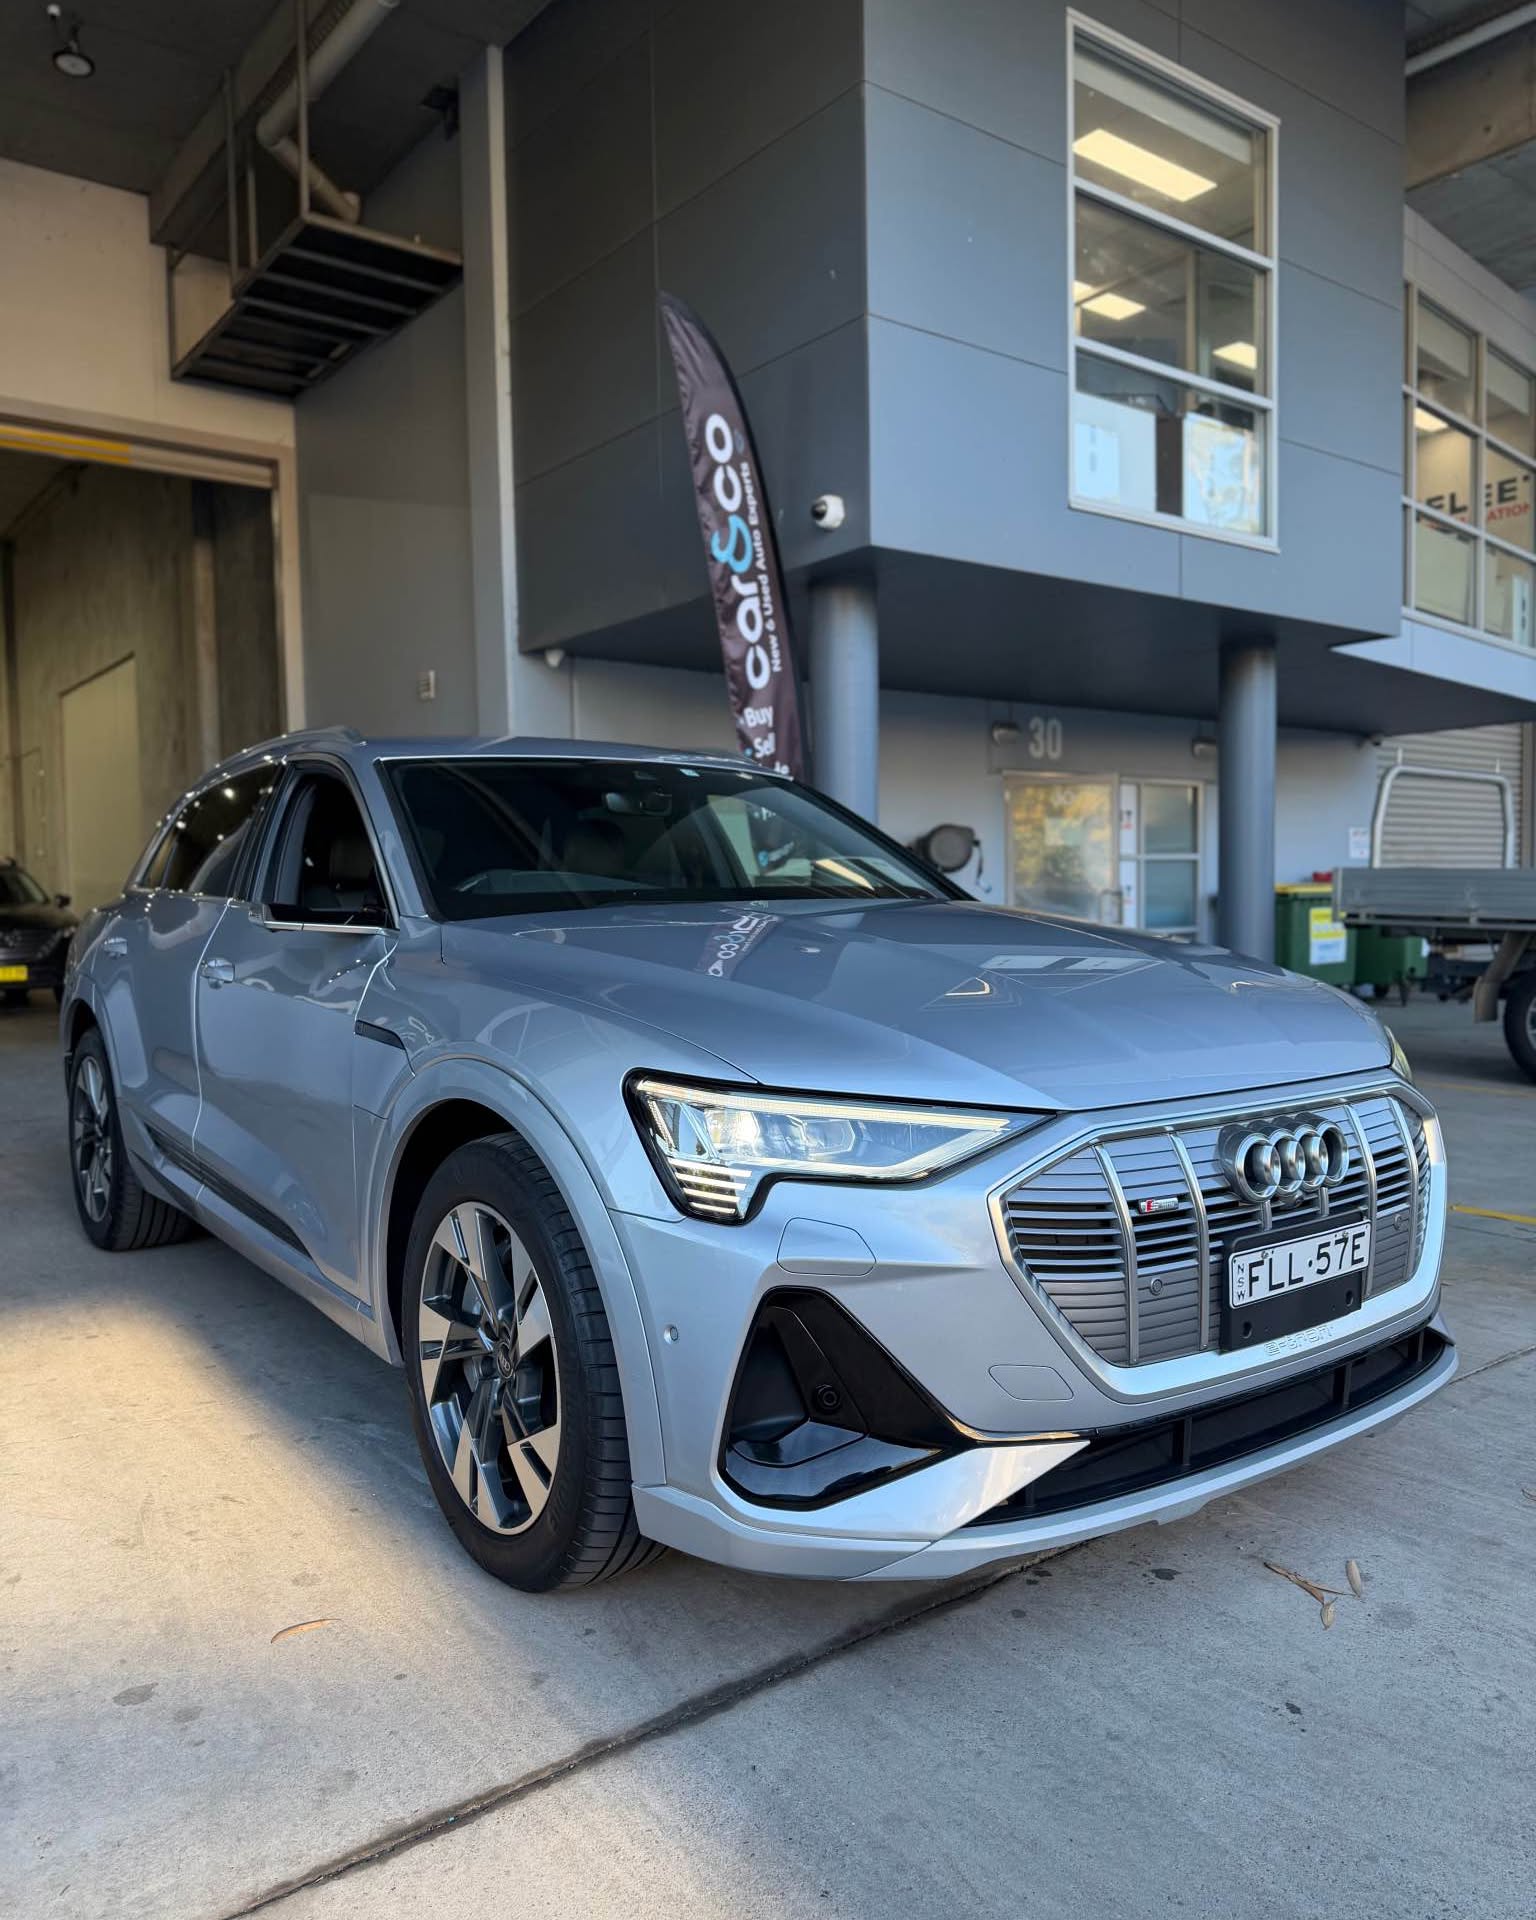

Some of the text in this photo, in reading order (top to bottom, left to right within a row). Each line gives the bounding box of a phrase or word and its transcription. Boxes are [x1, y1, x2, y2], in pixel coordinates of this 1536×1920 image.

[740, 462, 759, 526] Experts
[705, 413, 770, 690] car&co
[752, 528, 767, 570] Auto
[757, 574, 774, 616] Used
[769, 633, 782, 673] New
[744, 705, 773, 728] Buy
[1028, 716, 1063, 759] 30
